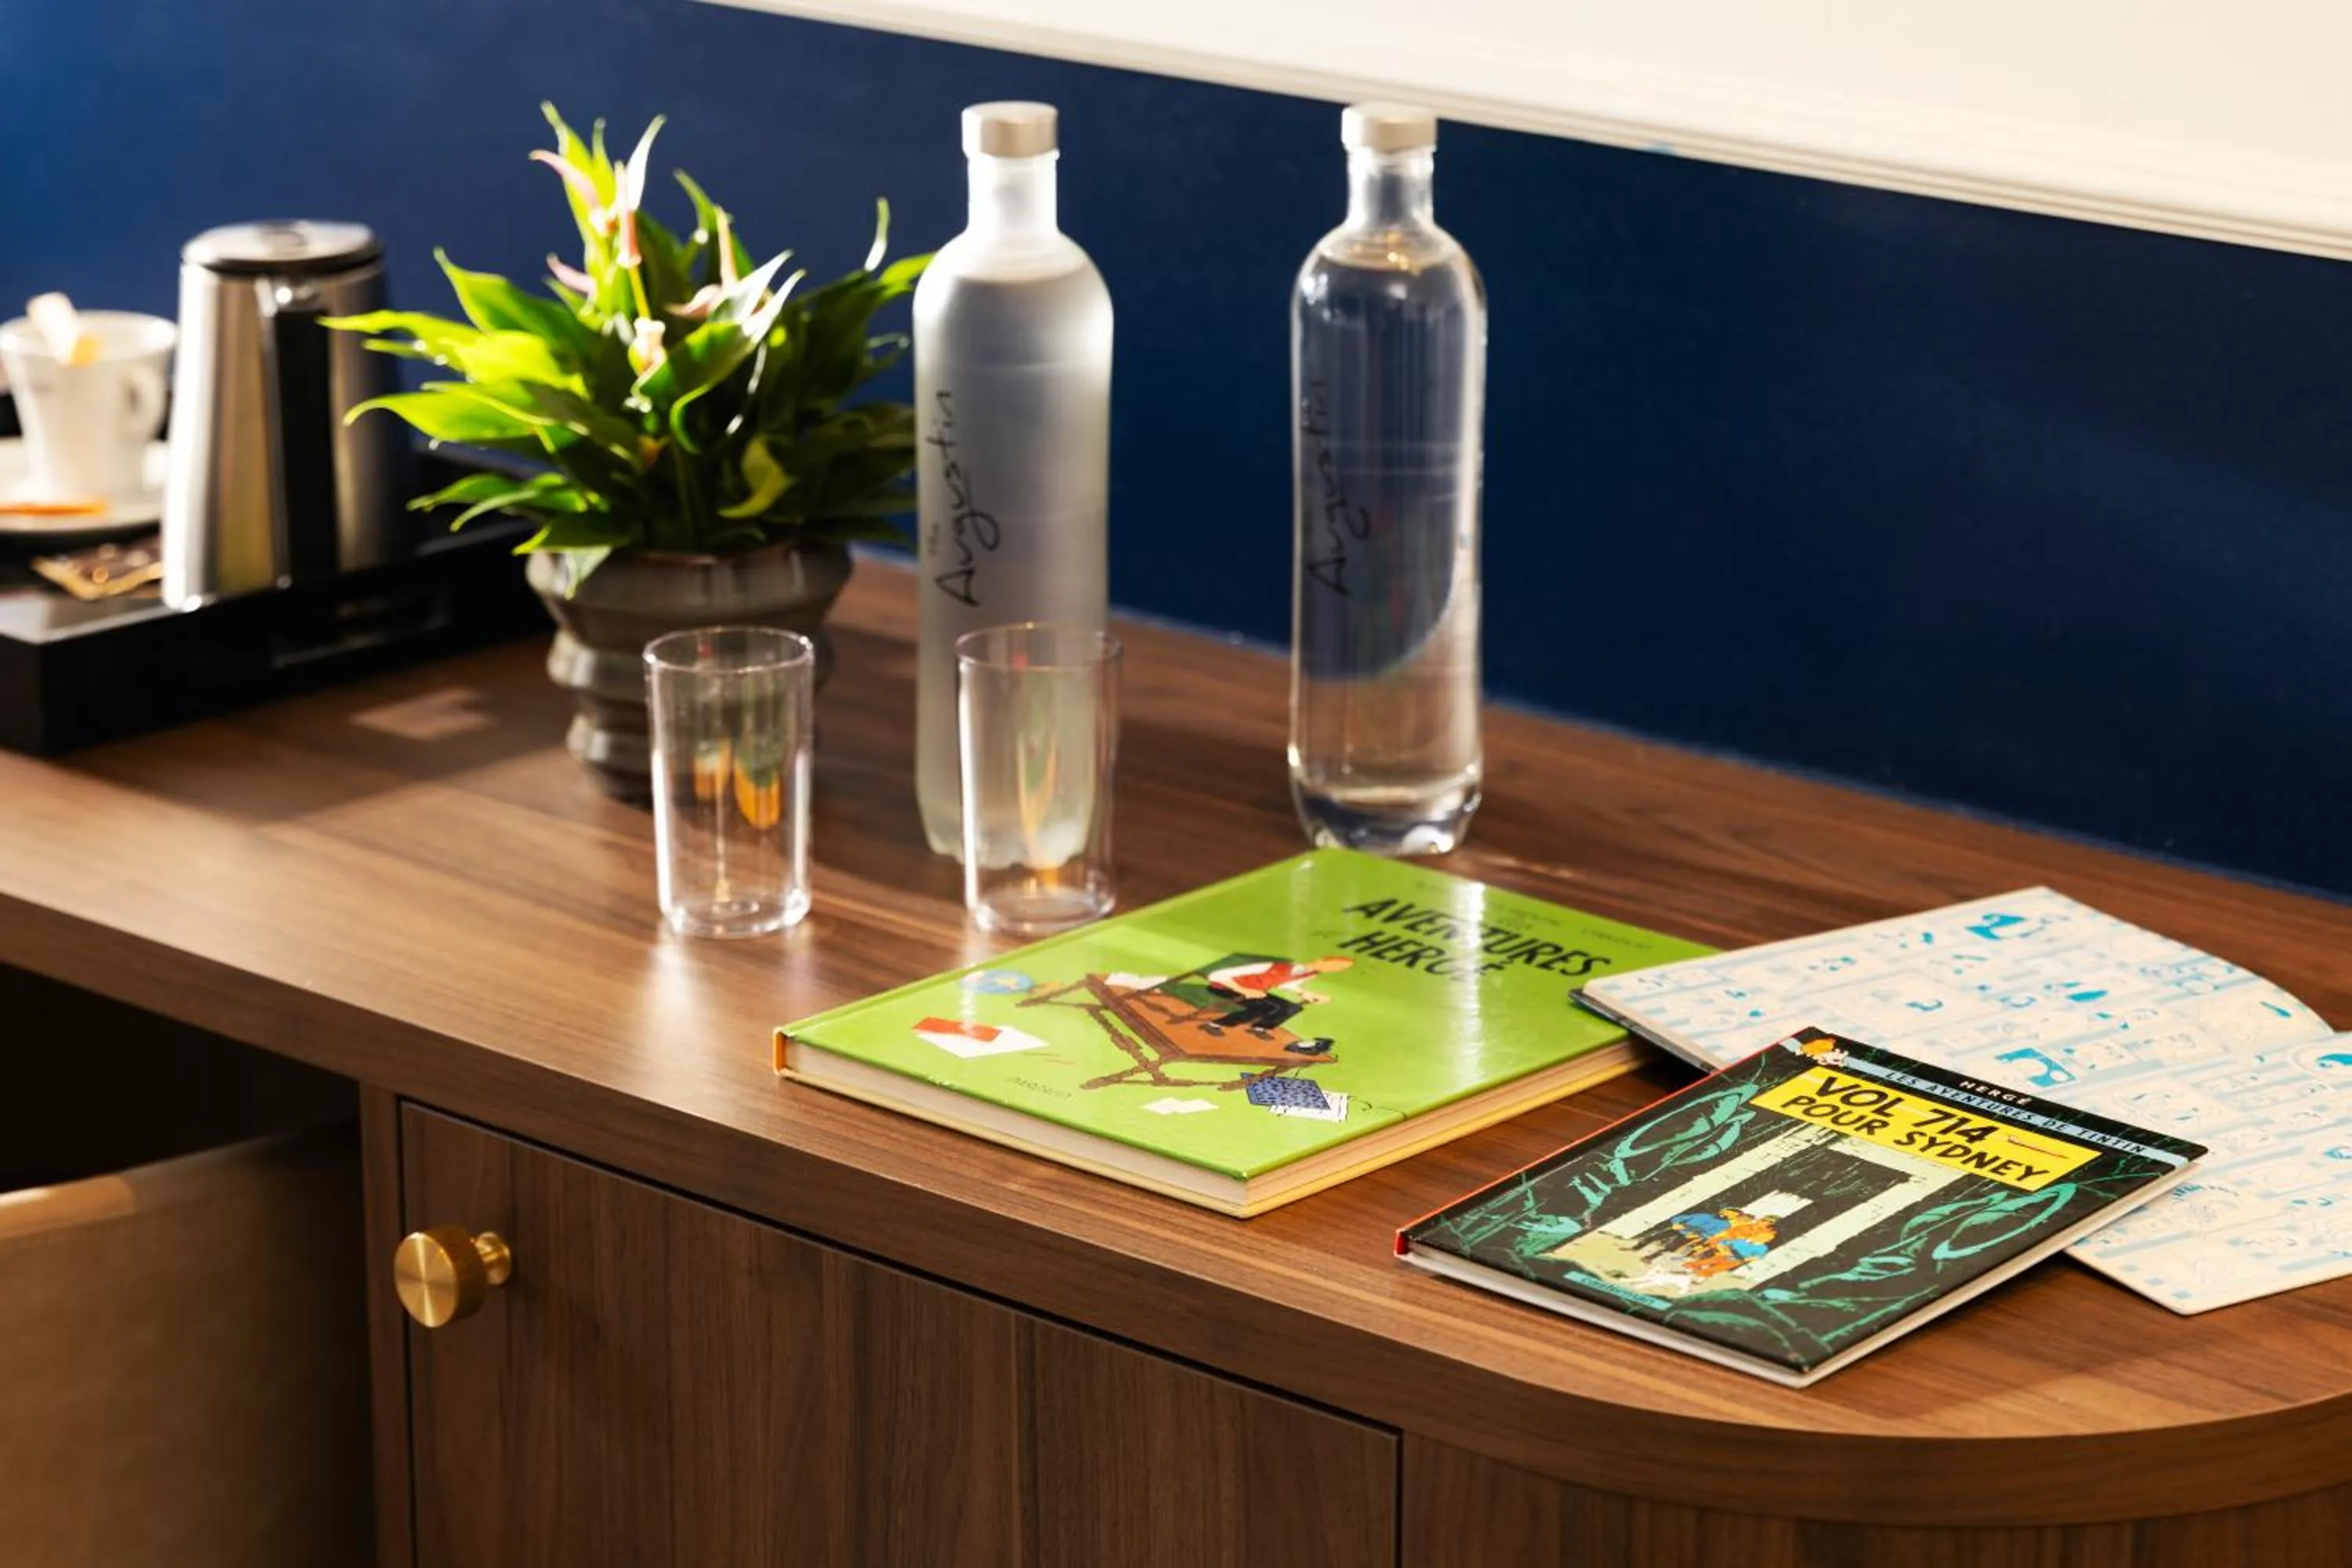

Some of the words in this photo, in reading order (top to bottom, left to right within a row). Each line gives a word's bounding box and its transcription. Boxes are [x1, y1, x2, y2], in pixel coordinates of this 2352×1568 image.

[926, 390, 1001, 608] Augustin
[1780, 1095, 1889, 1135] POUR
[1893, 1131, 2049, 1181] SYDNEY
[1816, 1076, 1904, 1117] VOL
[1911, 1108, 2000, 1143] 714
[1886, 1072, 1918, 1086] LES
[1926, 1084, 2036, 1121] AVENTURES
[2043, 1120, 2070, 1131] DE
[2079, 1129, 2147, 1153] TINTIN
